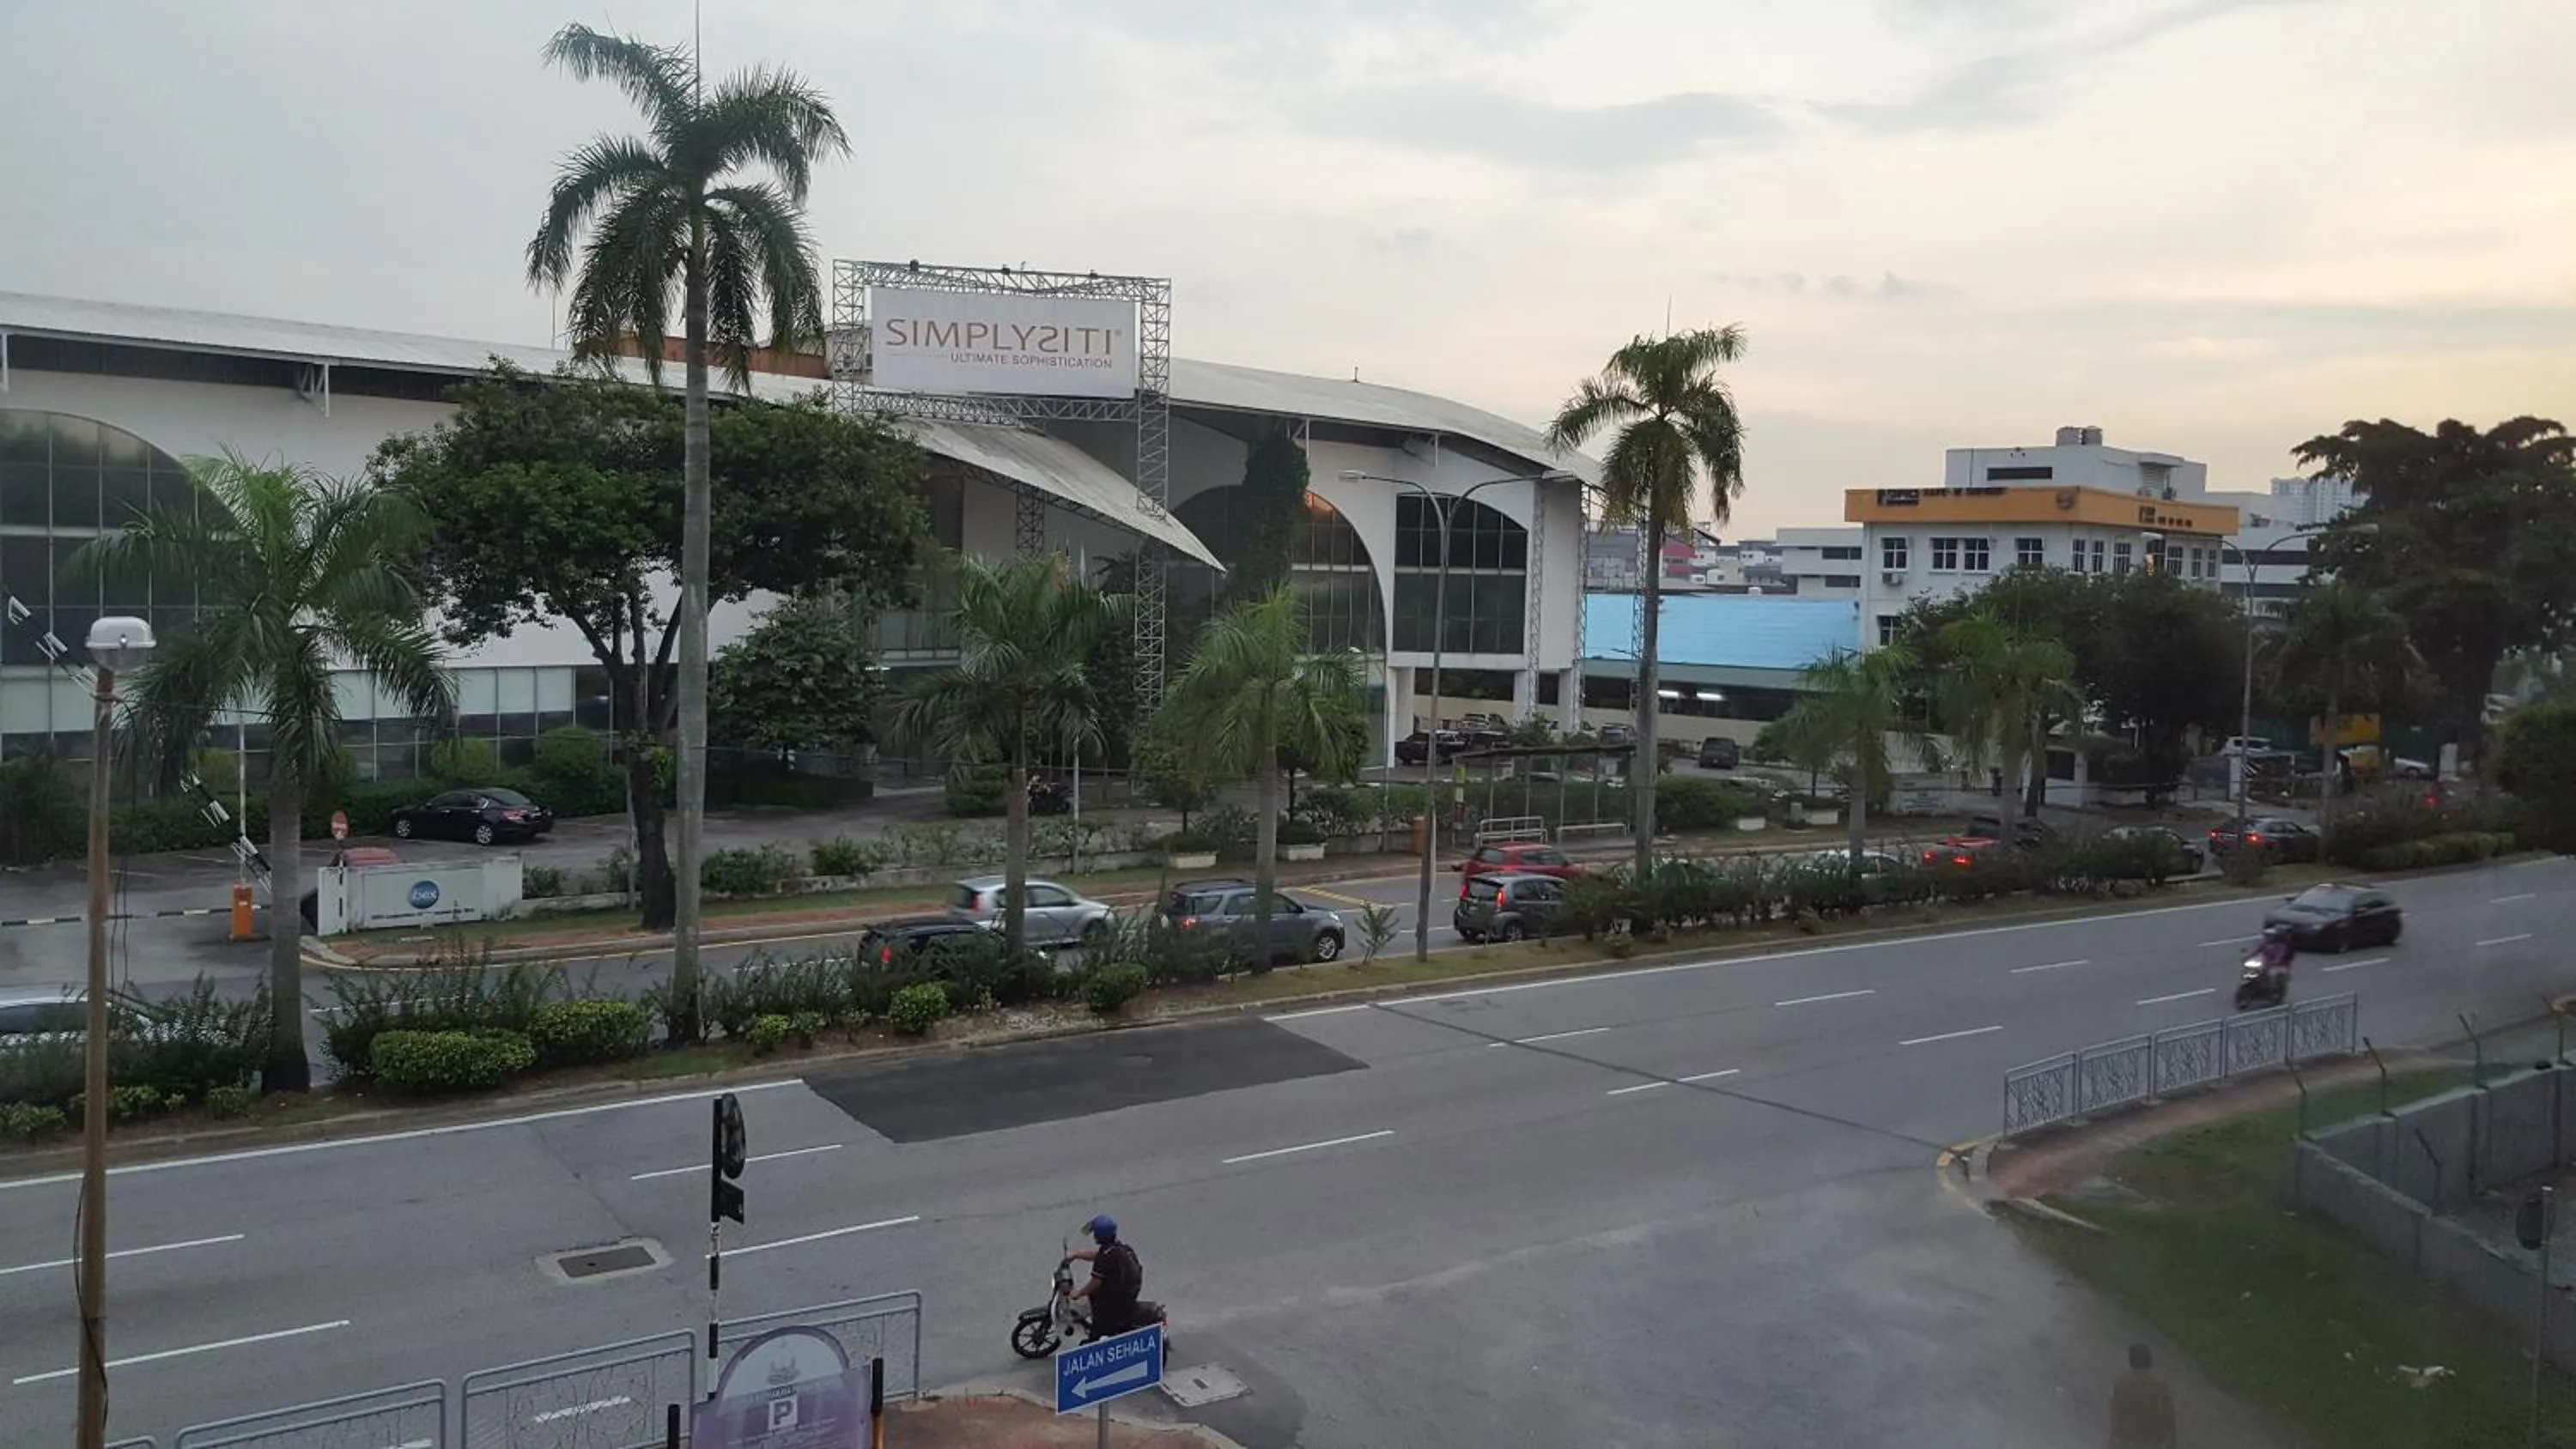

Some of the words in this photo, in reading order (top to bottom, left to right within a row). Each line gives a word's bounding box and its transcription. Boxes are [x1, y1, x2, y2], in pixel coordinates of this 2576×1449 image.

[951, 353, 1007, 365] ULTIMATE
[1012, 355, 1112, 368] SOPHISTICATION
[1062, 1350, 1103, 1376] JALAN
[1107, 1335, 1156, 1362] SEHALA
[774, 1400, 793, 1425] P
